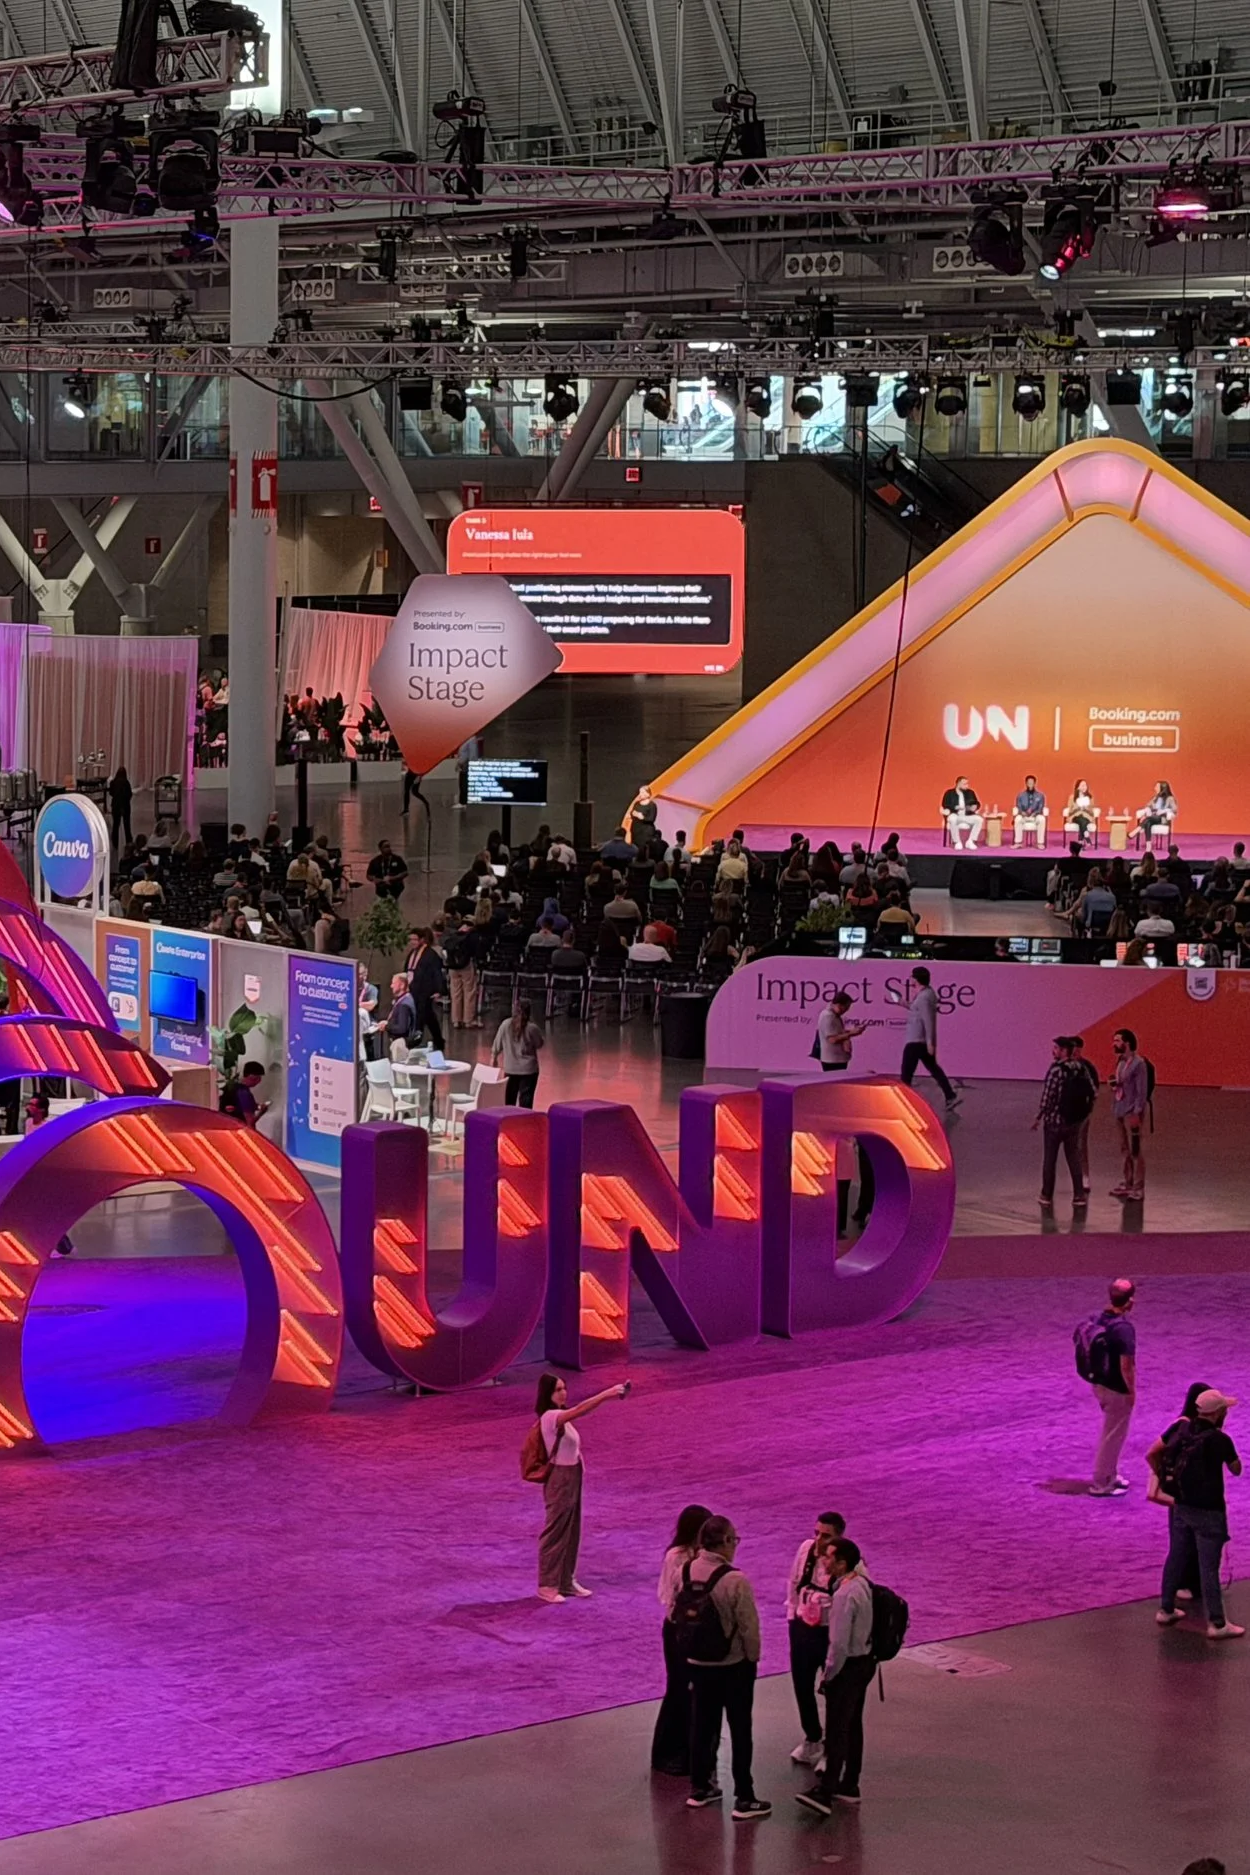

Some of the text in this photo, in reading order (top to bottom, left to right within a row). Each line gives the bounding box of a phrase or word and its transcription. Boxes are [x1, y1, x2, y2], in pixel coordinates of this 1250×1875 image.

[466, 528, 510, 540] Vanessa
[414, 610, 452, 618] Presented
[413, 622, 473, 632] Booking.com
[409, 643, 508, 674] Impact
[408, 676, 485, 708] Stage
[943, 703, 1180, 750] UN Booking.com
[1103, 732, 1164, 746] business
[43, 831, 90, 859] Canva
[295, 970, 350, 991] From concept
[298, 984, 347, 1002] to customer
[757, 973, 976, 1014] Impact Stge
[756, 1014, 798, 1024] Presented
